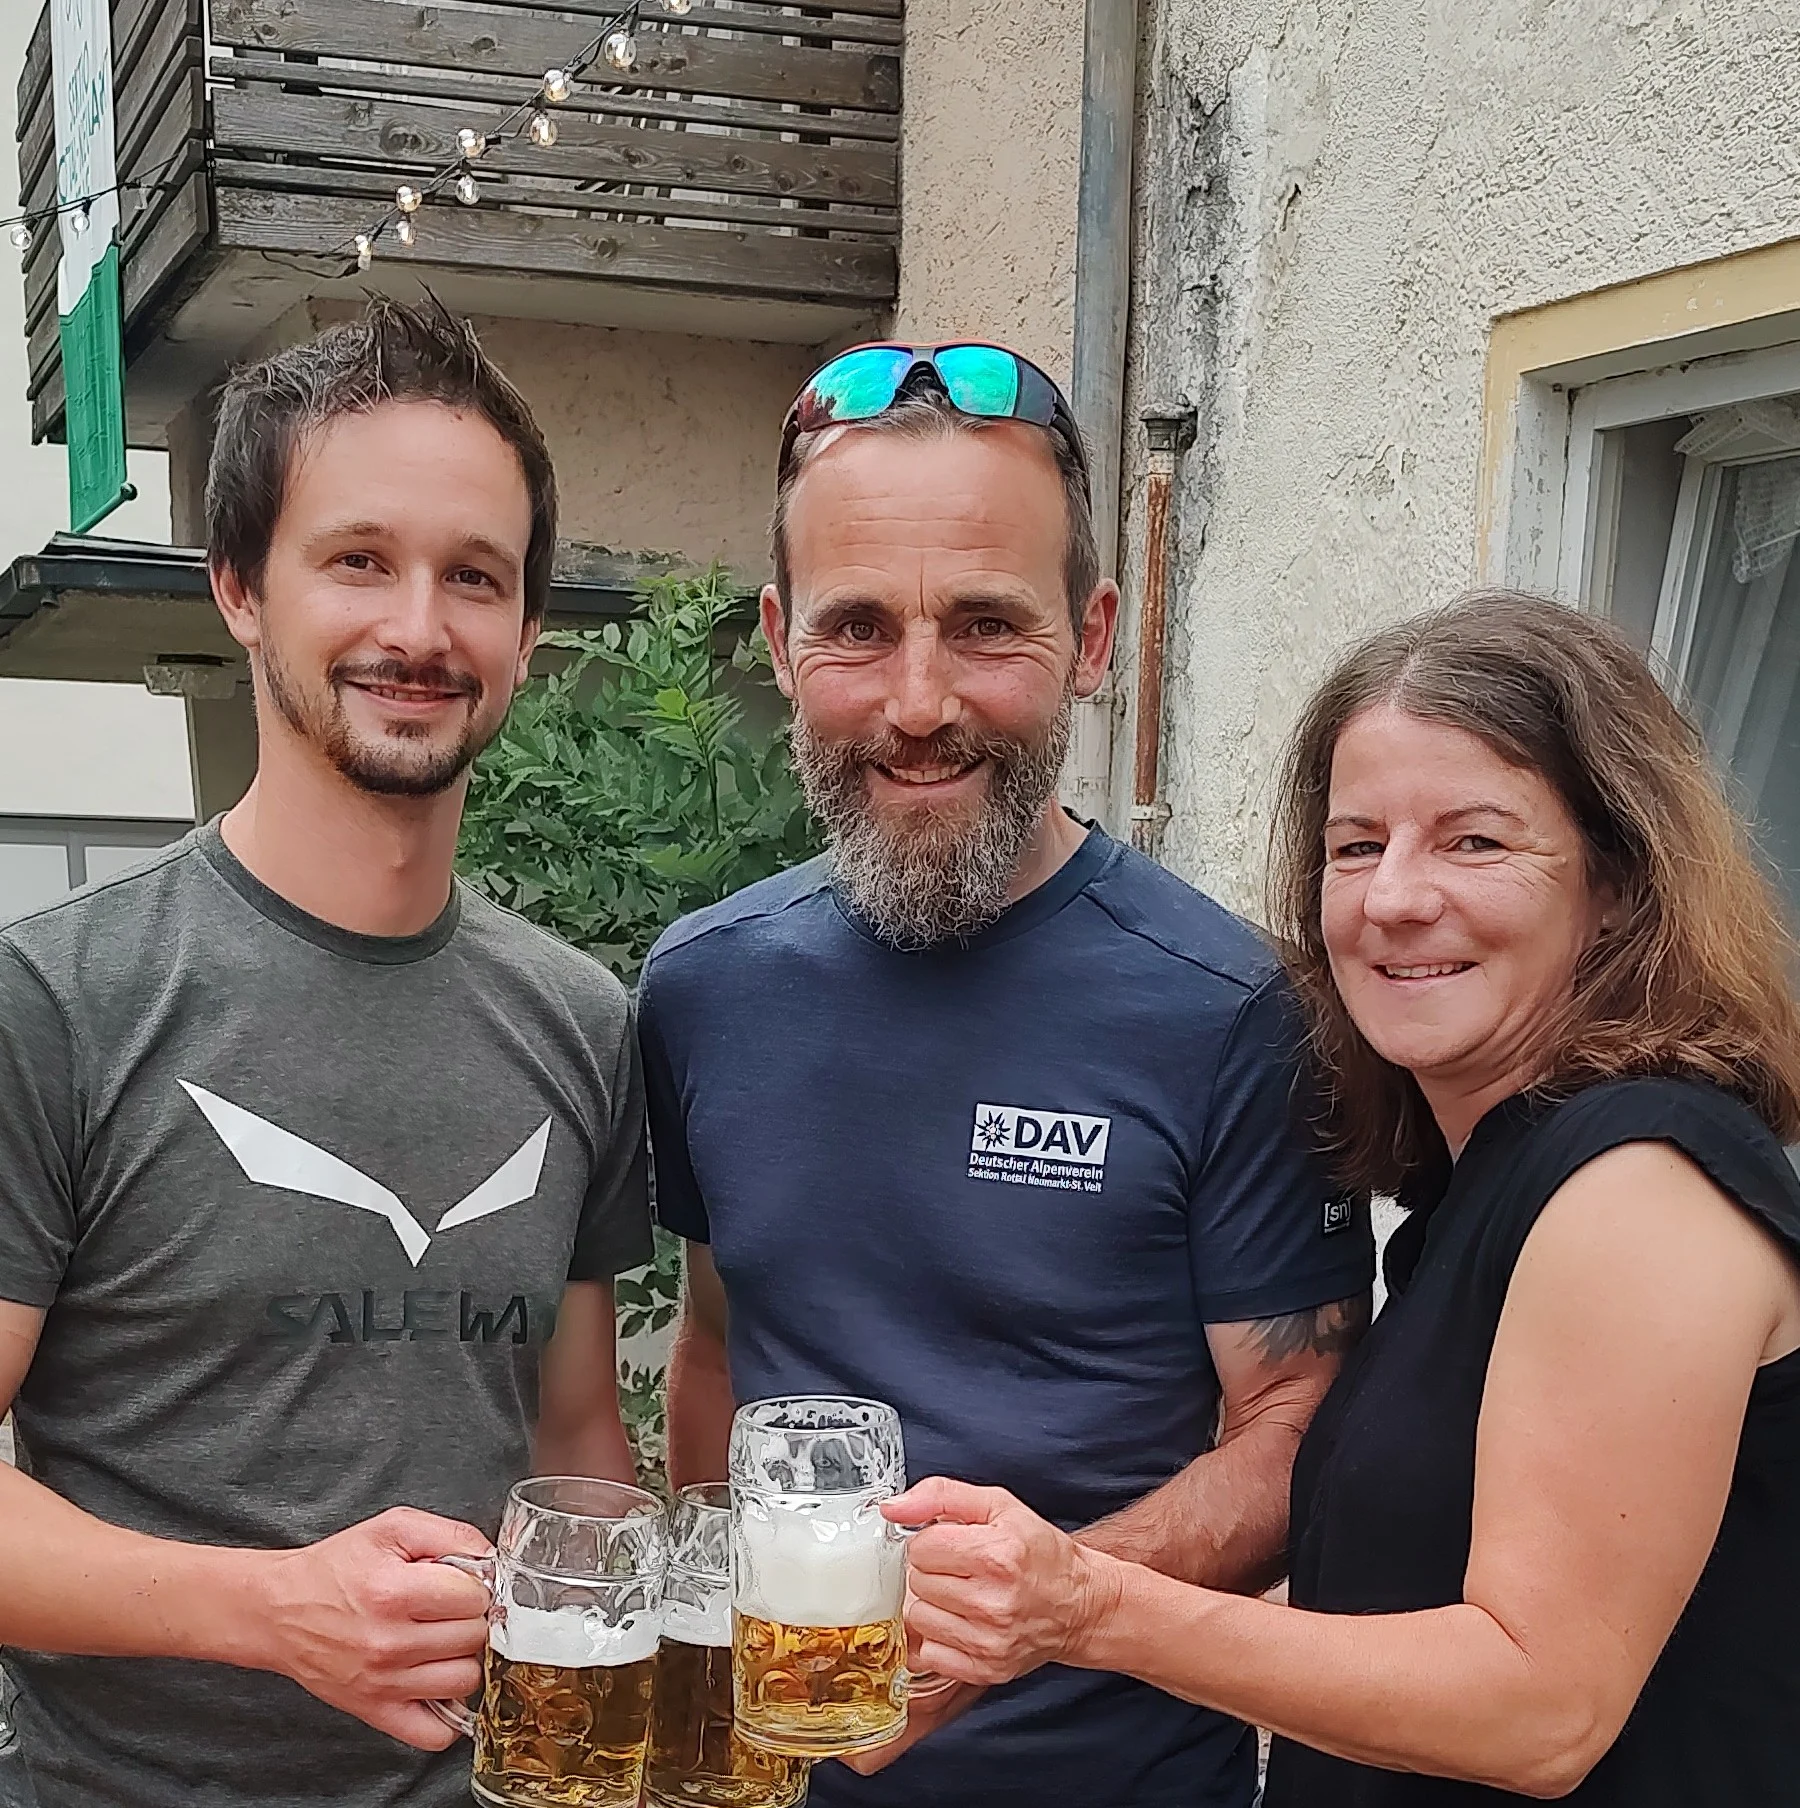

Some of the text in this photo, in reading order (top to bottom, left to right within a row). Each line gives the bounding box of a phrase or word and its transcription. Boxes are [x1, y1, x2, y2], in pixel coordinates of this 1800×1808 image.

[1014, 1115, 1103, 1157] DAV
[967, 1168, 1000, 1181] Sektion
[969, 1152, 1104, 1180] Deutscher Alpenverein
[260, 1288, 528, 1344] SALEWA
